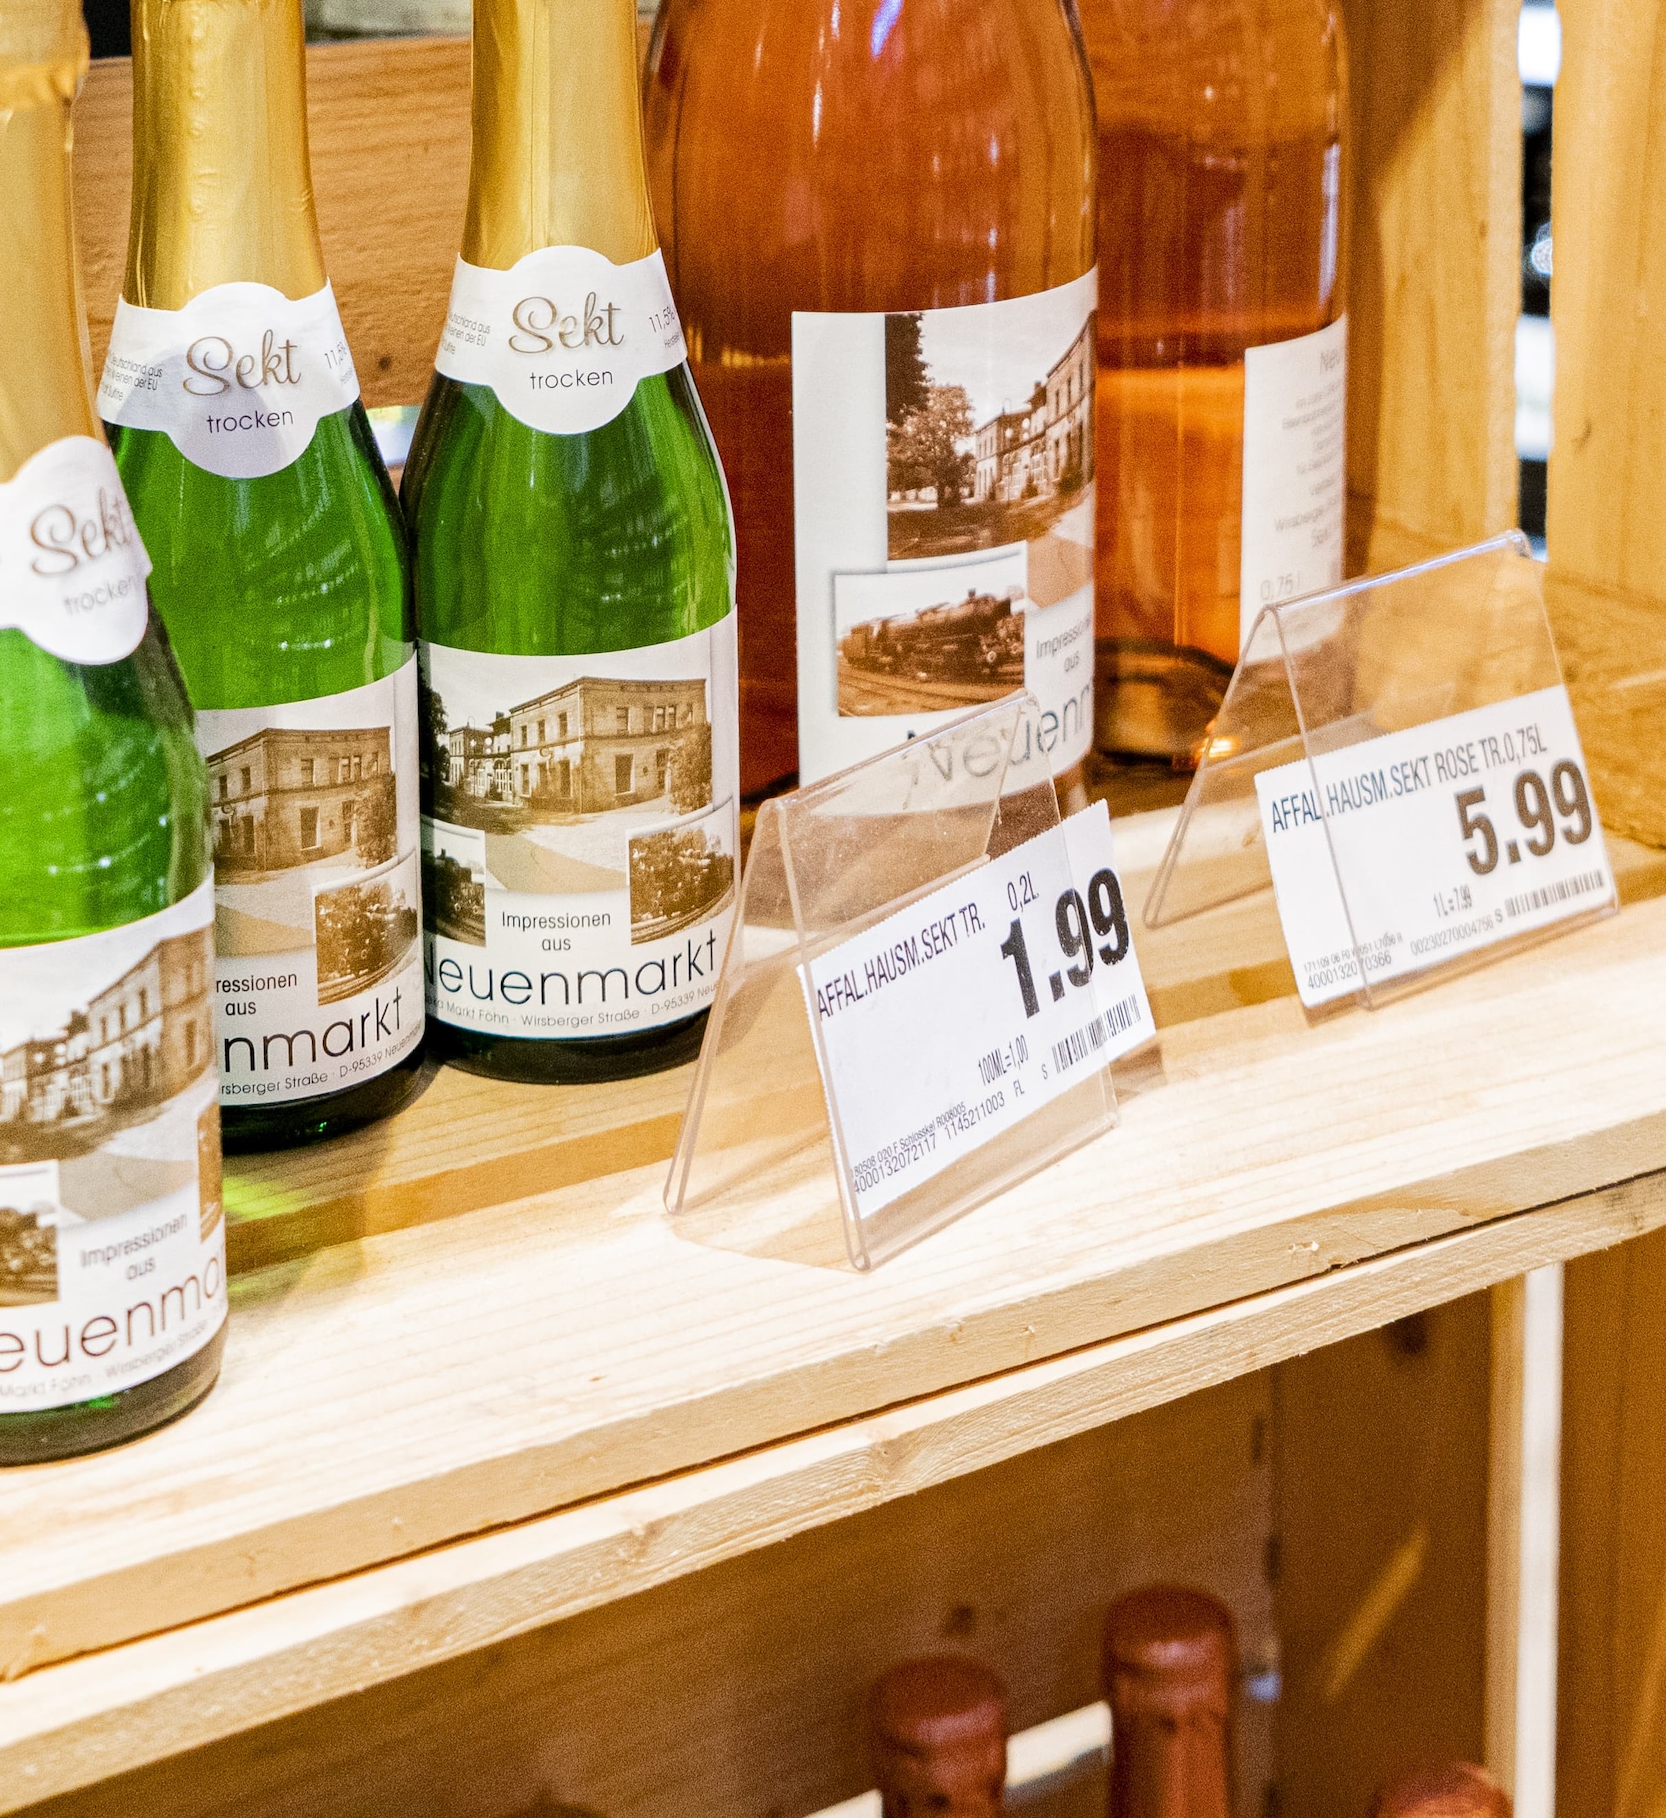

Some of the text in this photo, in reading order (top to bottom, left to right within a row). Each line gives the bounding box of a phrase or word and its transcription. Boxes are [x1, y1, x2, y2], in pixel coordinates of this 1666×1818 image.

[508, 291, 624, 354] Sekt
[183, 329, 302, 396] Sekt
[147, 377, 158, 391] EU
[530, 369, 613, 391] trocken
[207, 410, 294, 434] trocken
[1064, 649, 1081, 673] aus
[1434, 741, 1480, 784] ROSE
[1453, 757, 1593, 877] 5.99
[502, 911, 612, 932] Impressionen
[541, 936, 572, 952] aus
[1000, 867, 1130, 1019] 1.99
[817, 913, 959, 1021] AFFAL.HAUSM.SEKT
[959, 902, 986, 938] TR.
[216, 973, 298, 994] ressionen
[225, 1001, 257, 1017] aus
[446, 1001, 475, 1019] Markt
[522, 1014, 594, 1029] Wirsberger
[598, 1008, 640, 1024] Straße
[651, 990, 695, 1016] D-95339
[224, 986, 403, 1073] nmarkt
[221, 1079, 281, 1096] rsberger
[285, 1072, 329, 1090] Straße
[339, 1053, 382, 1078] D-95339
[1013, 1078, 1026, 1098] FL
[80, 1213, 188, 1268] Impressionen
[126, 1257, 157, 1281] aus
